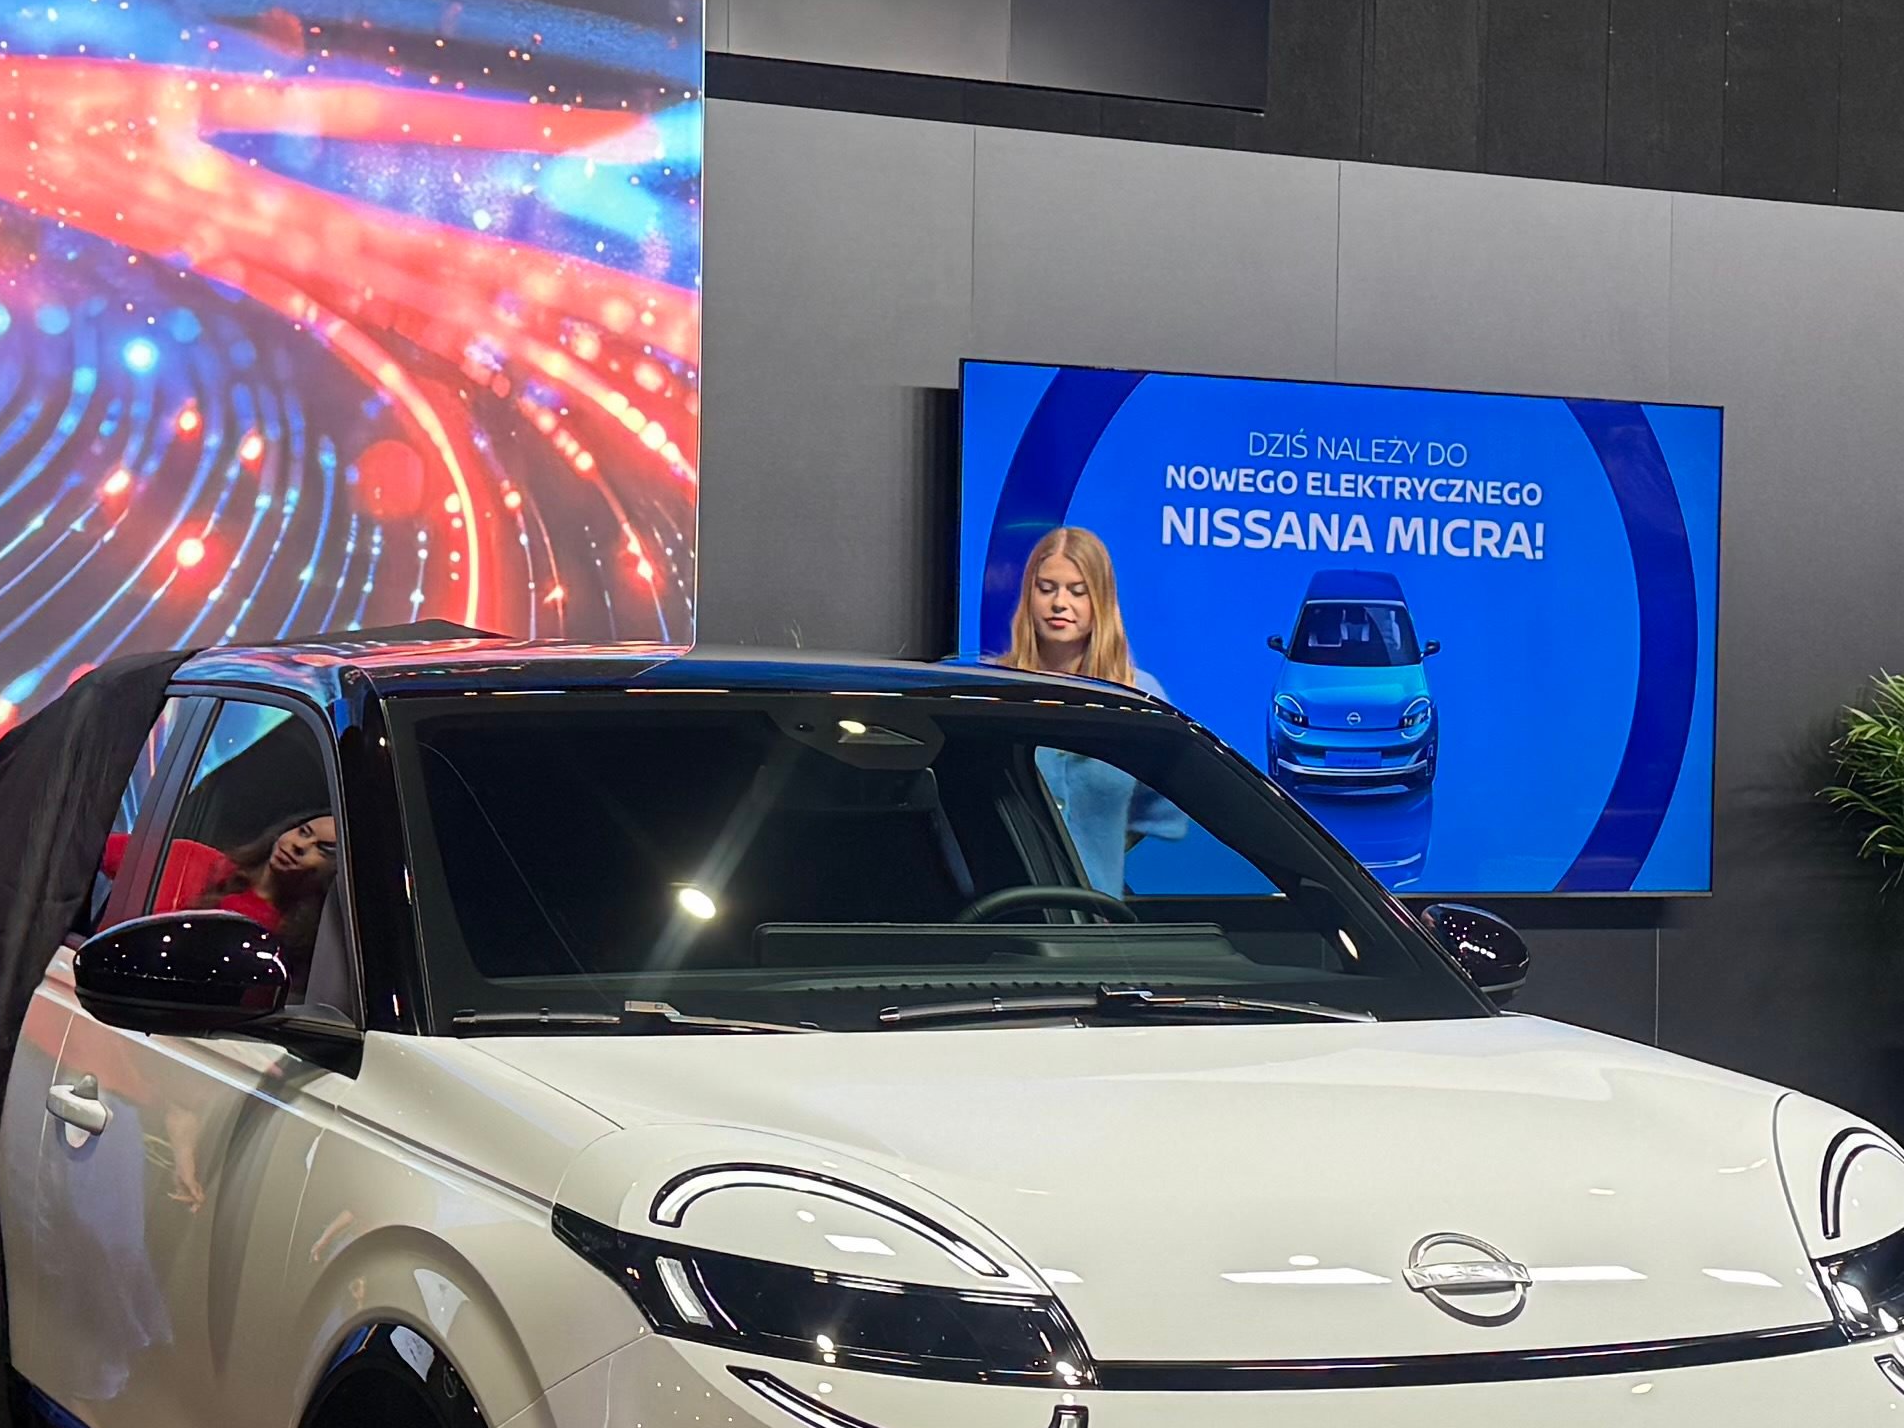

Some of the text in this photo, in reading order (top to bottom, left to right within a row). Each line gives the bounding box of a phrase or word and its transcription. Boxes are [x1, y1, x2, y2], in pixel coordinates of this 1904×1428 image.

[1249, 428, 1468, 467] DZIŚ NALEŻY DO
[1165, 464, 1542, 506] NOWEGO ELEKTRYCZNEGO
[1161, 505, 1545, 560] NISSANA MICRA!
